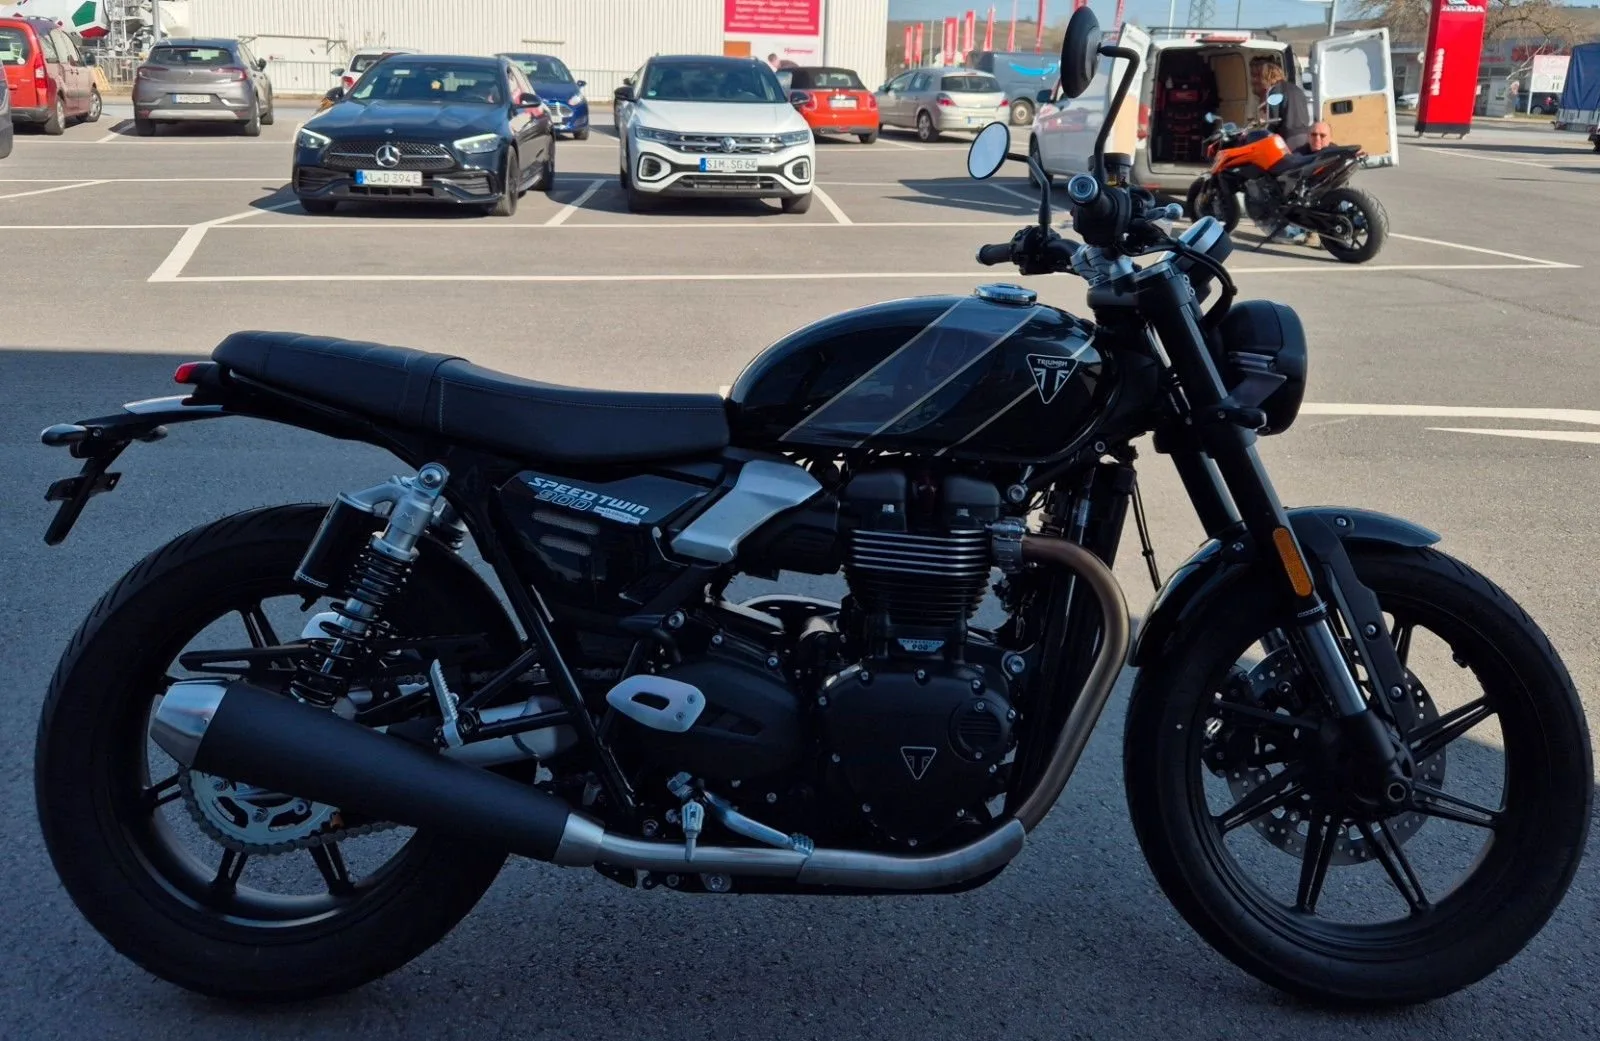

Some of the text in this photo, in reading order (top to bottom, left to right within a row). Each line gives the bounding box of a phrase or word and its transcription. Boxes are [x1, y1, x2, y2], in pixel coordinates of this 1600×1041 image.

[1036, 358, 1068, 367] TRIUMPH
[528, 477, 598, 500] SPEED
[598, 495, 650, 515] TWIN
[534, 489, 593, 511] 900
